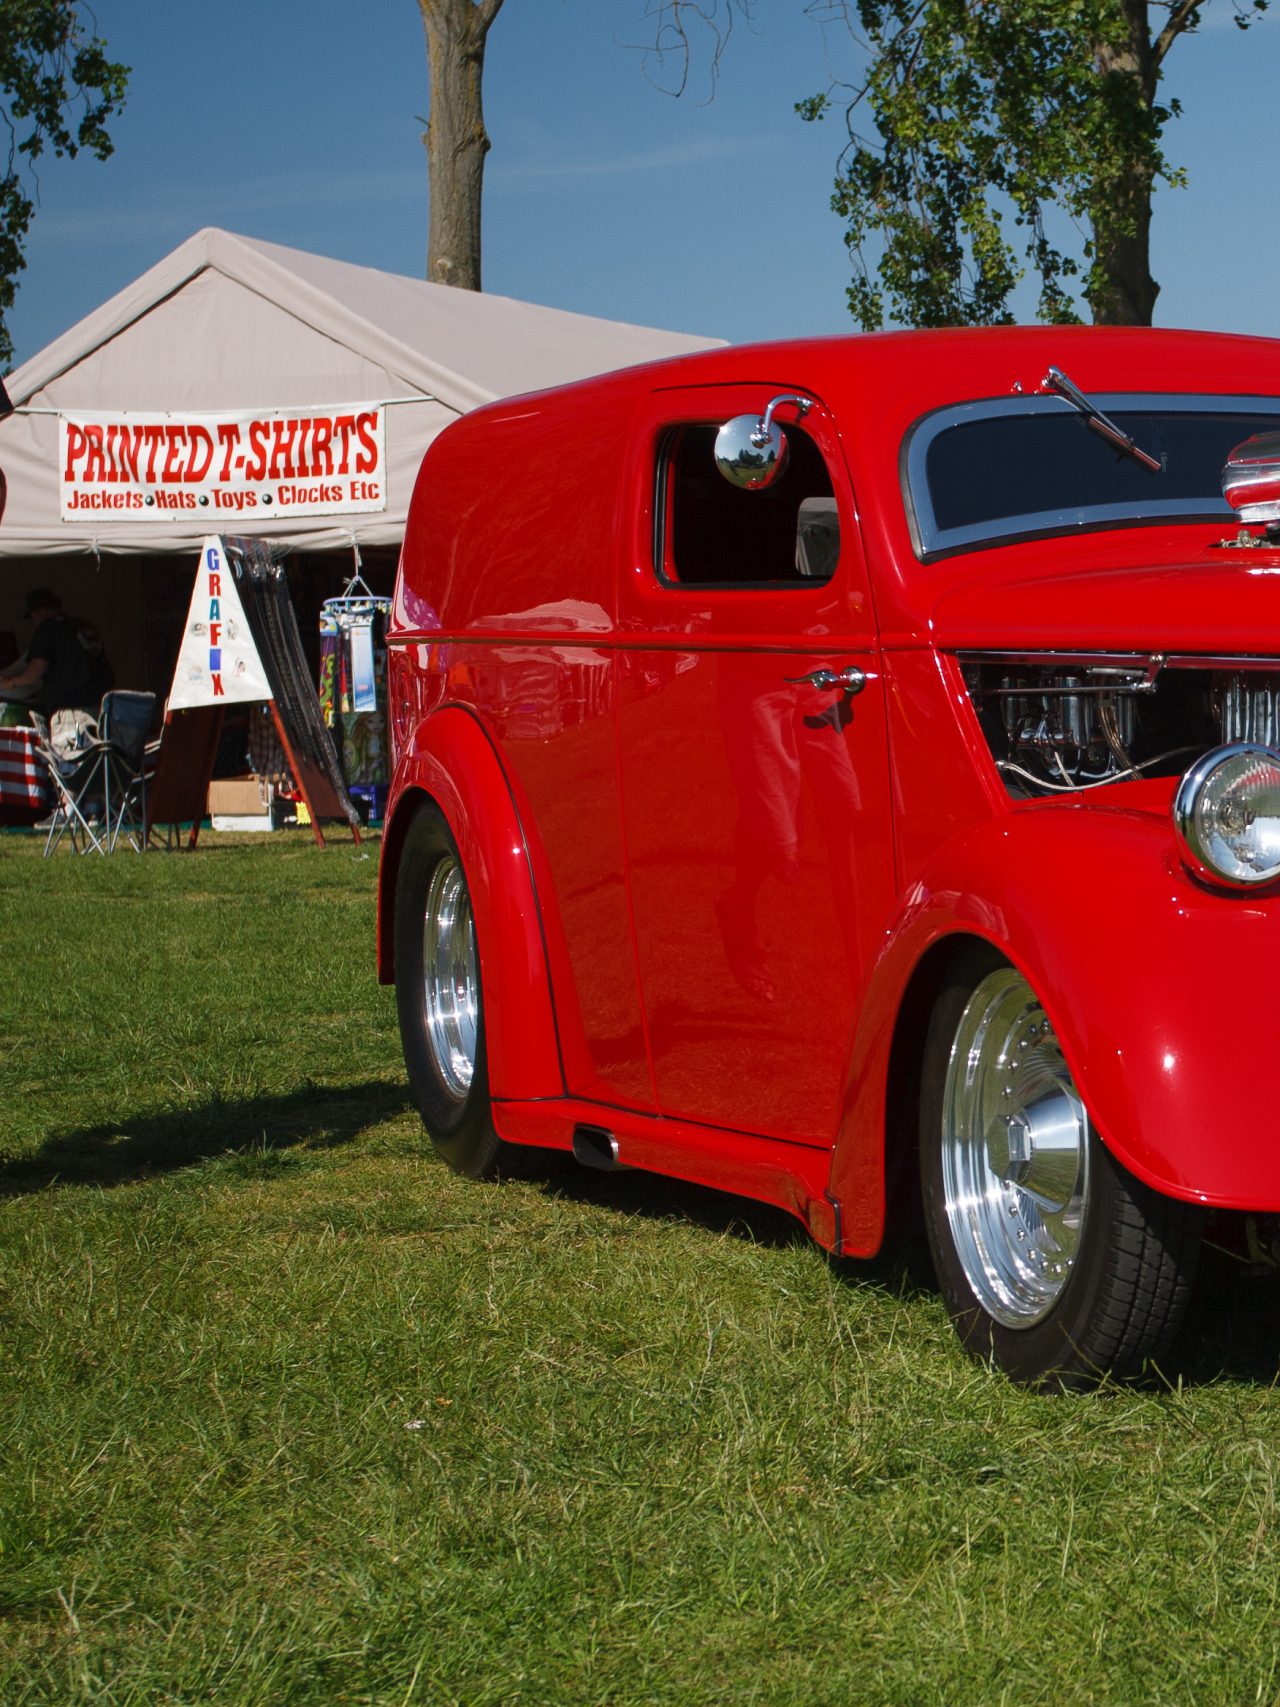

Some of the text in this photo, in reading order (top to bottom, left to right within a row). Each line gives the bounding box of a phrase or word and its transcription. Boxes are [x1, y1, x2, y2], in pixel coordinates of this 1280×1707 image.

[64, 411, 379, 483] PRINTED T-SHIRTS
[67, 480, 380, 511] Jackets Hats Toys Clocks Etc
[206, 548, 225, 696] GRAFIX
